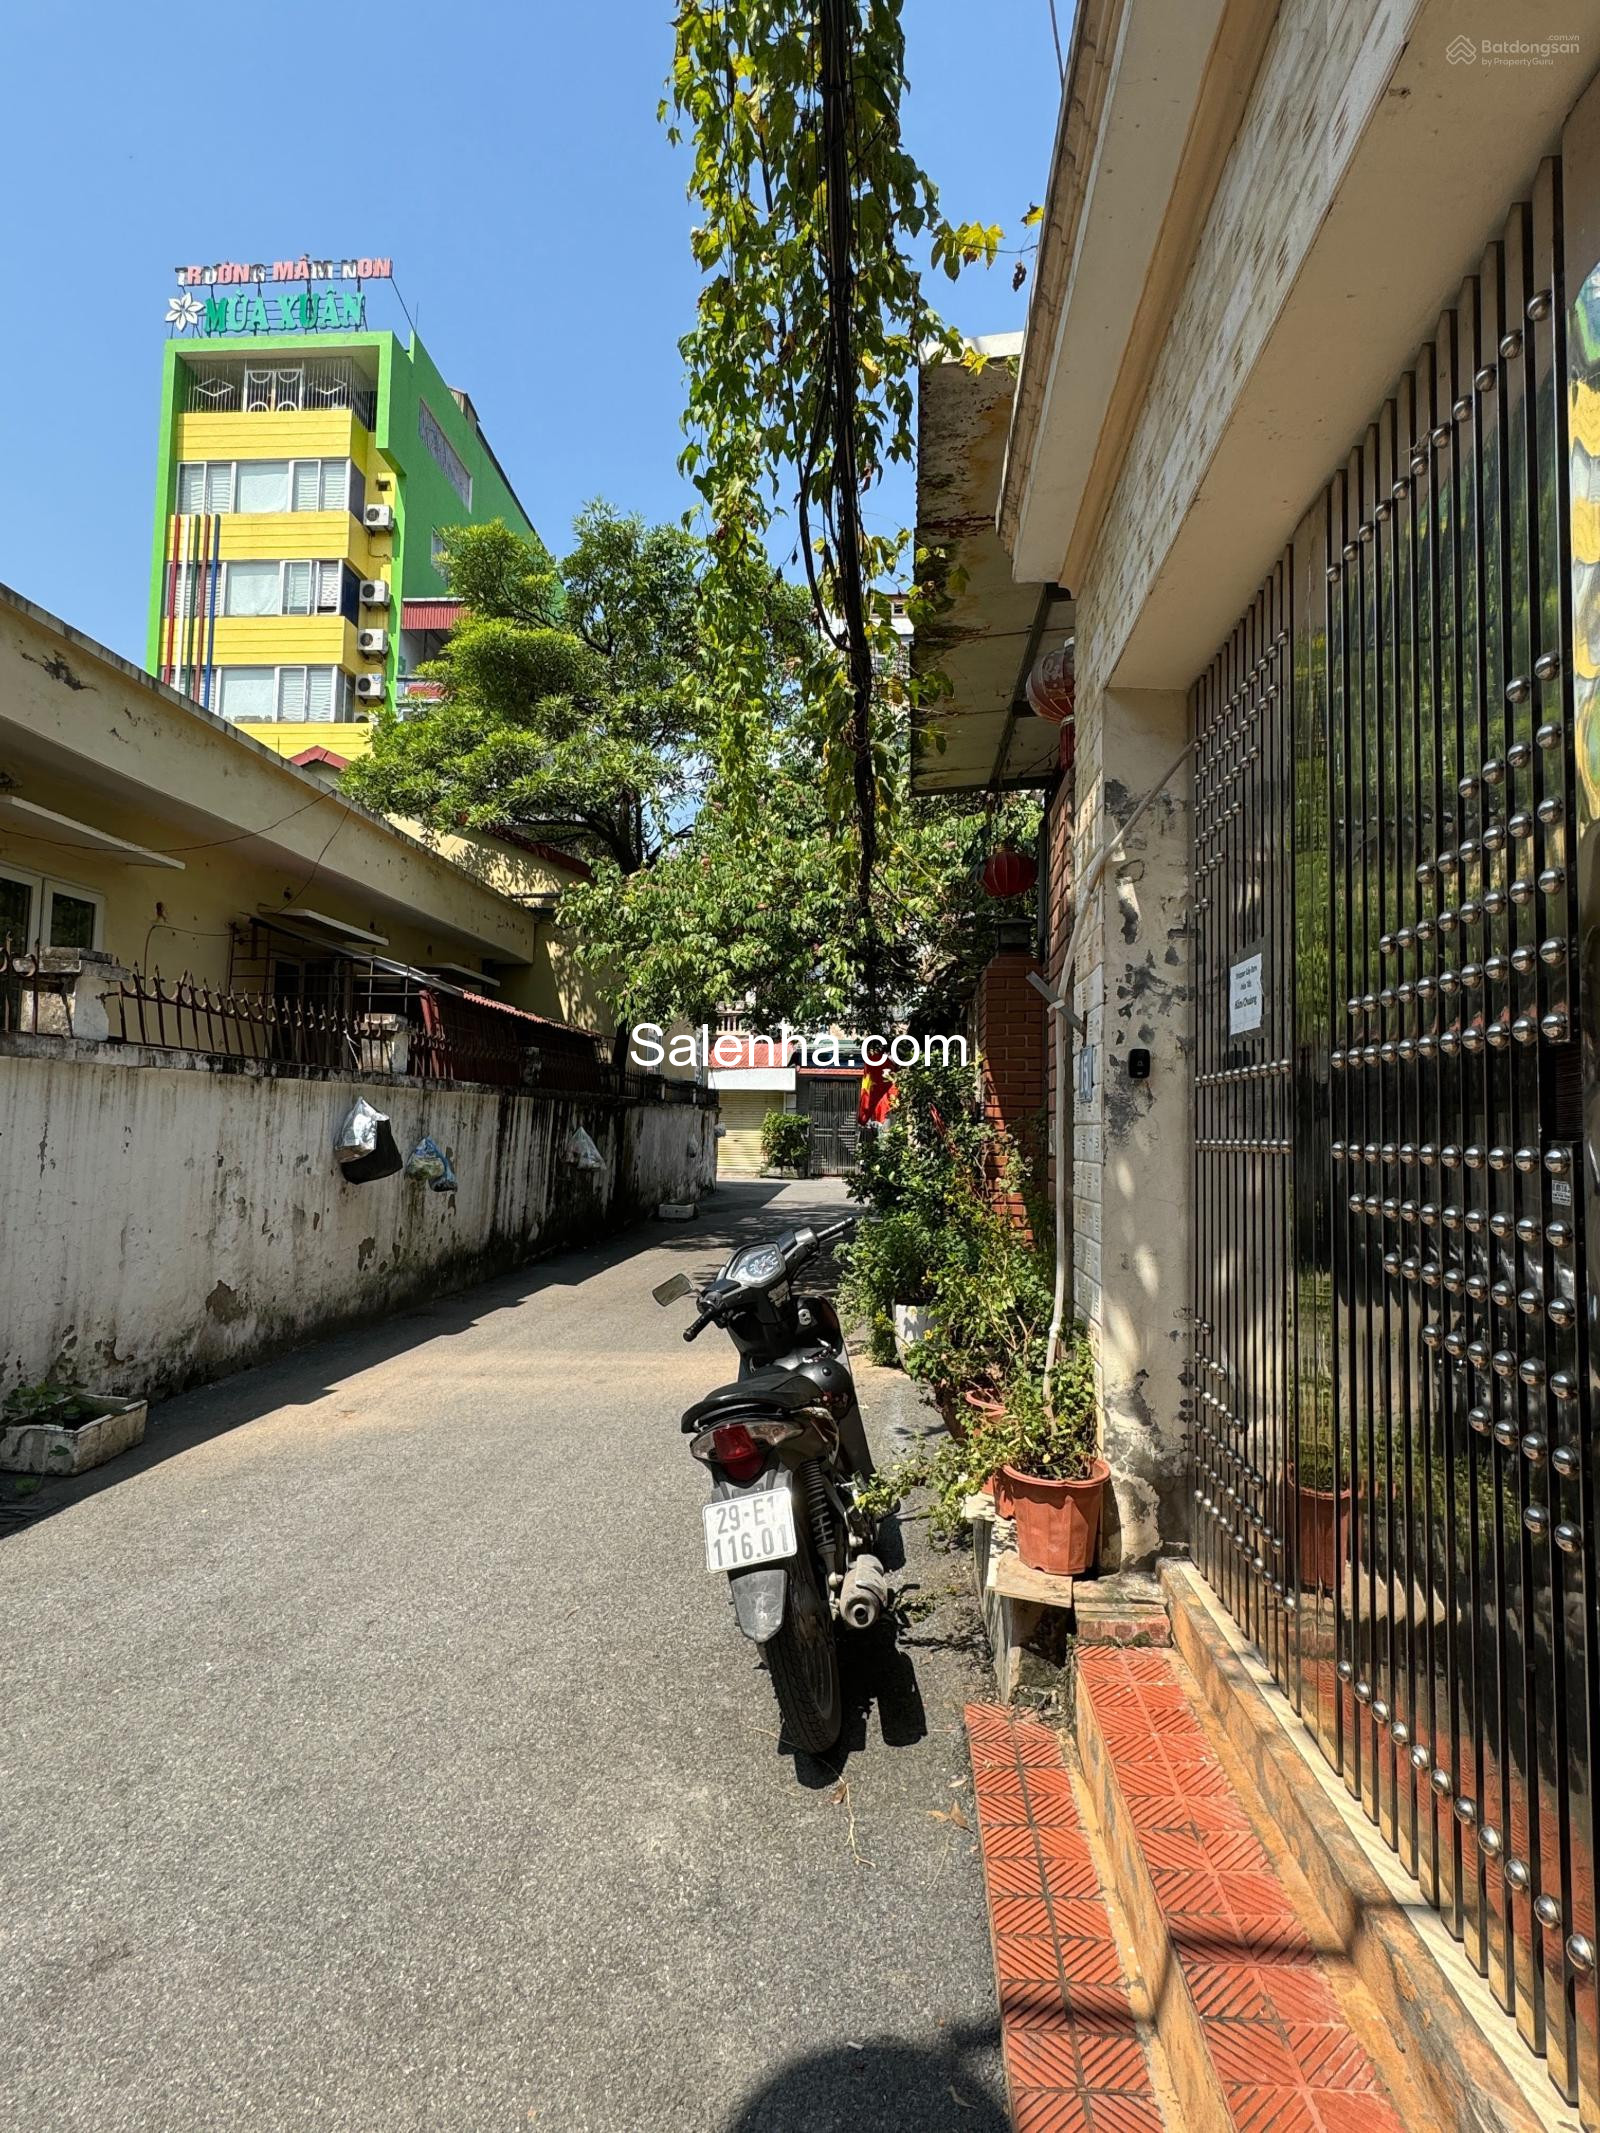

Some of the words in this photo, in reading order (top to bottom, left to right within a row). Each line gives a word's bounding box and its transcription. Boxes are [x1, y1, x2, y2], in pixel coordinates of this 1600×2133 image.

[341, 257, 392, 281] NON
[204, 288, 270, 333] MÙA
[276, 283, 365, 330] XUÂN
[716, 1495, 776, 1535] 29-E1
[713, 1523, 789, 1567] 116.01
